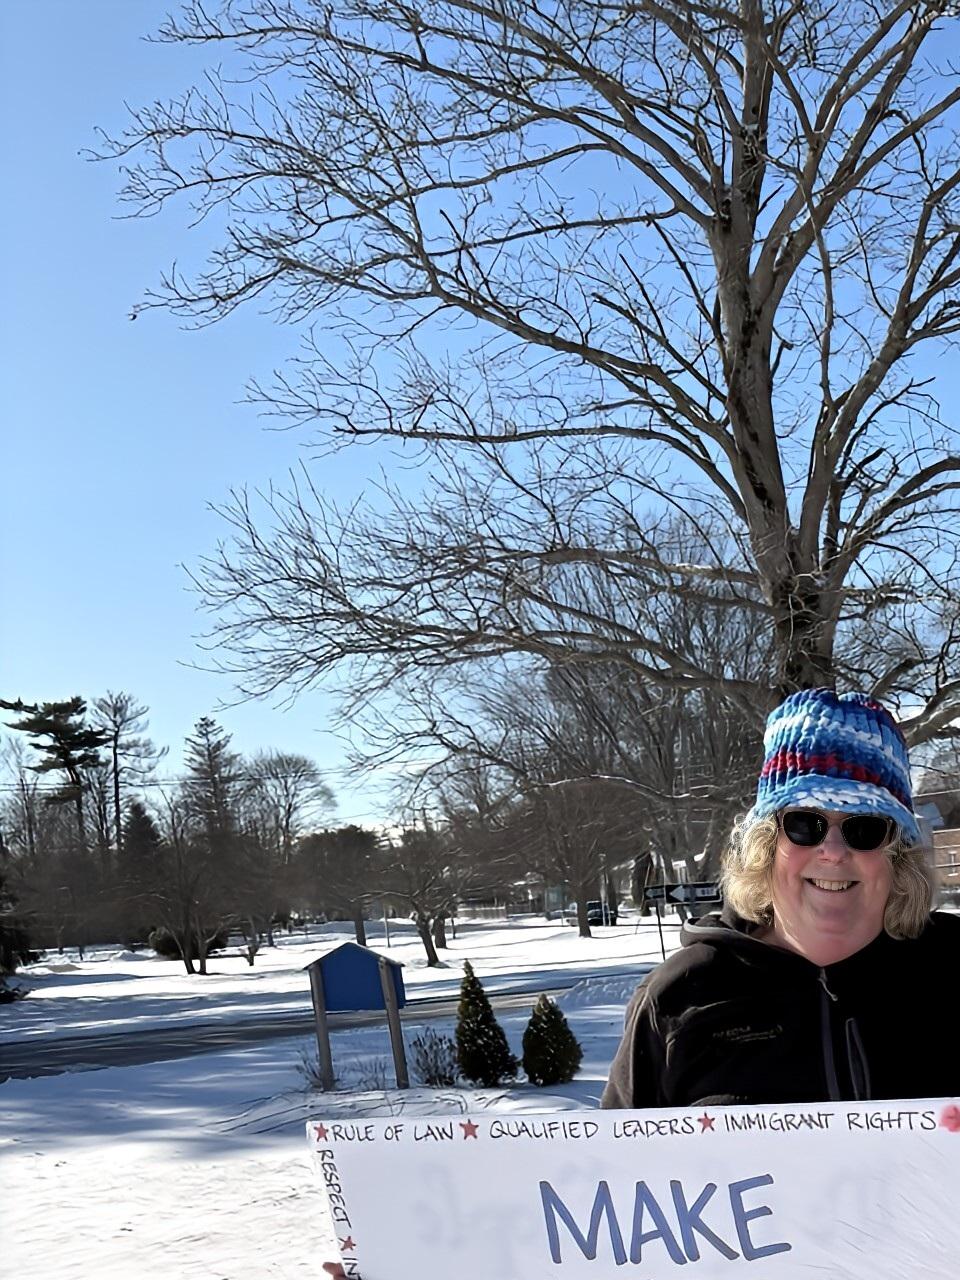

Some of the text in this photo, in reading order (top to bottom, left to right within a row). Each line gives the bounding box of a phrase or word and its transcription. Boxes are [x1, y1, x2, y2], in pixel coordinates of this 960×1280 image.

[331, 1110, 937, 1142] RULE OF LAW QUALIFIED LEADERS IMMIGRANT RIGHTS
[317, 1149, 352, 1229] RESPECT
[539, 1173, 793, 1266] MAKE
